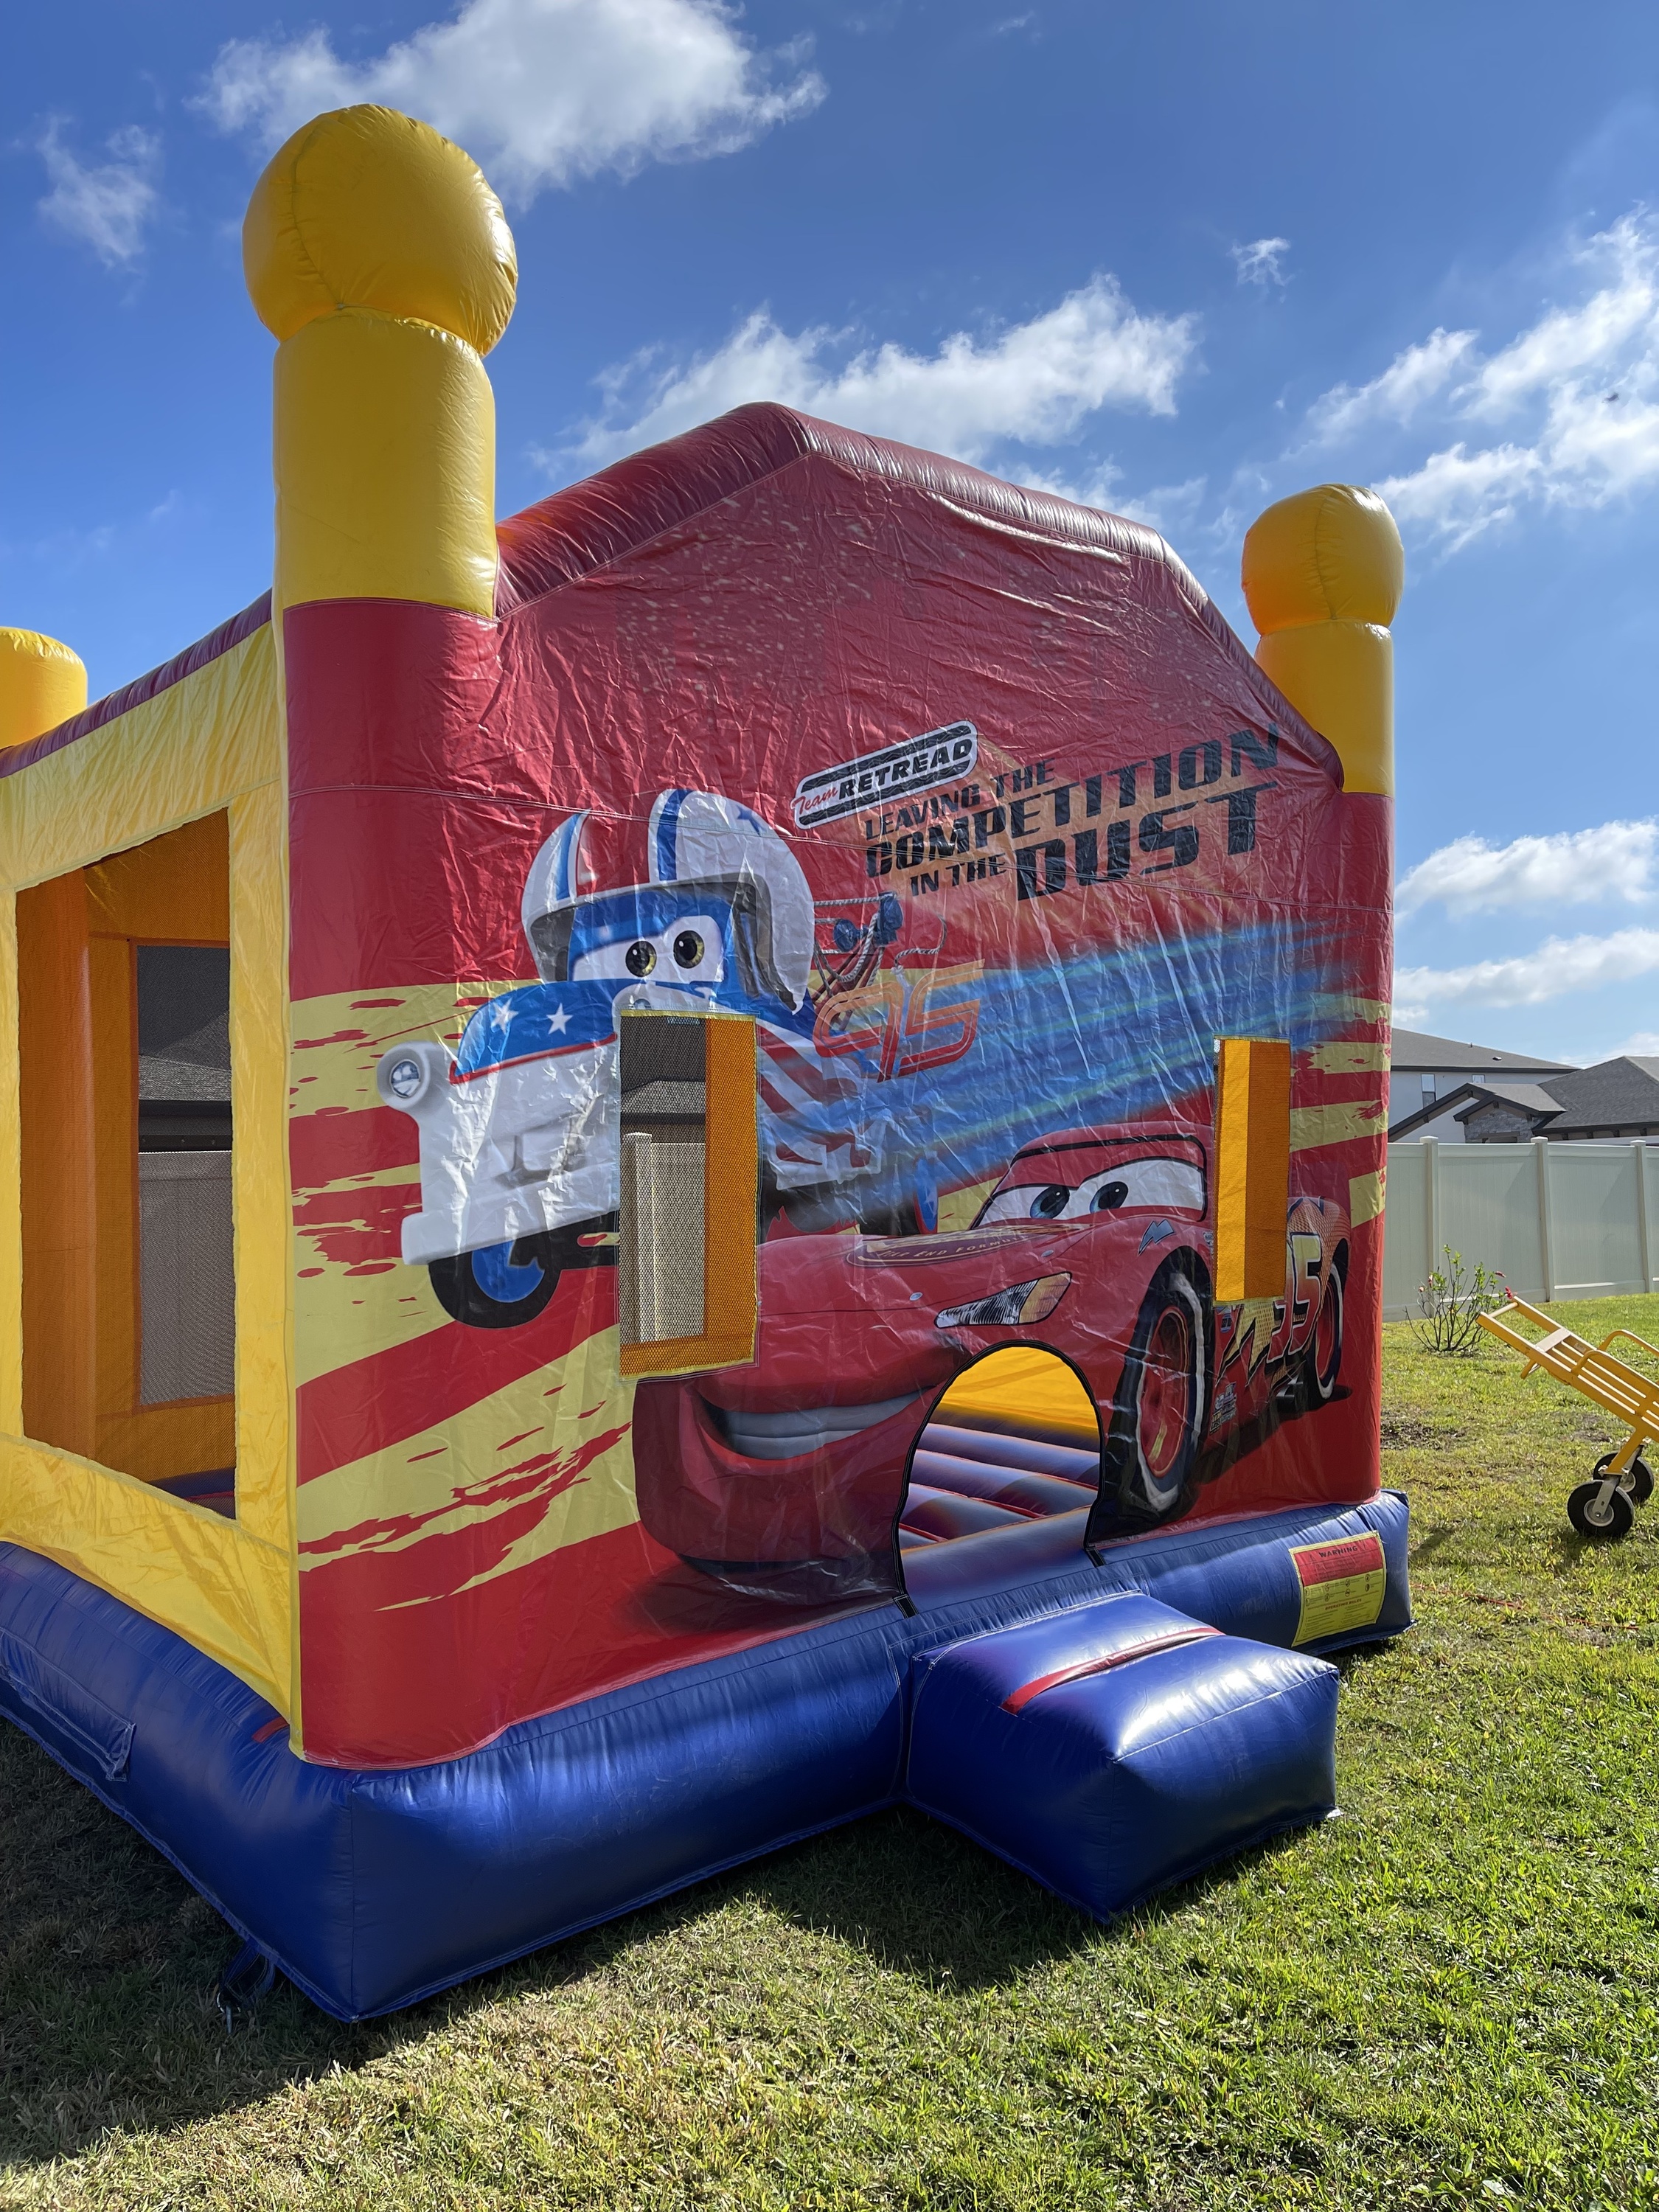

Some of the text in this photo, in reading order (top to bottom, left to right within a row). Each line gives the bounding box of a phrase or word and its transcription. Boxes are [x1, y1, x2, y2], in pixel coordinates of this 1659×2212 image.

[792, 738, 973, 815] Team RETREAD
[866, 758, 1055, 840] LEAVING THE
[866, 723, 1279, 878] COMPETITION
[910, 781, 1278, 902] IN THE DUST
[813, 959, 985, 1083] 95
[1318, 1545, 1358, 1558] WARNING
